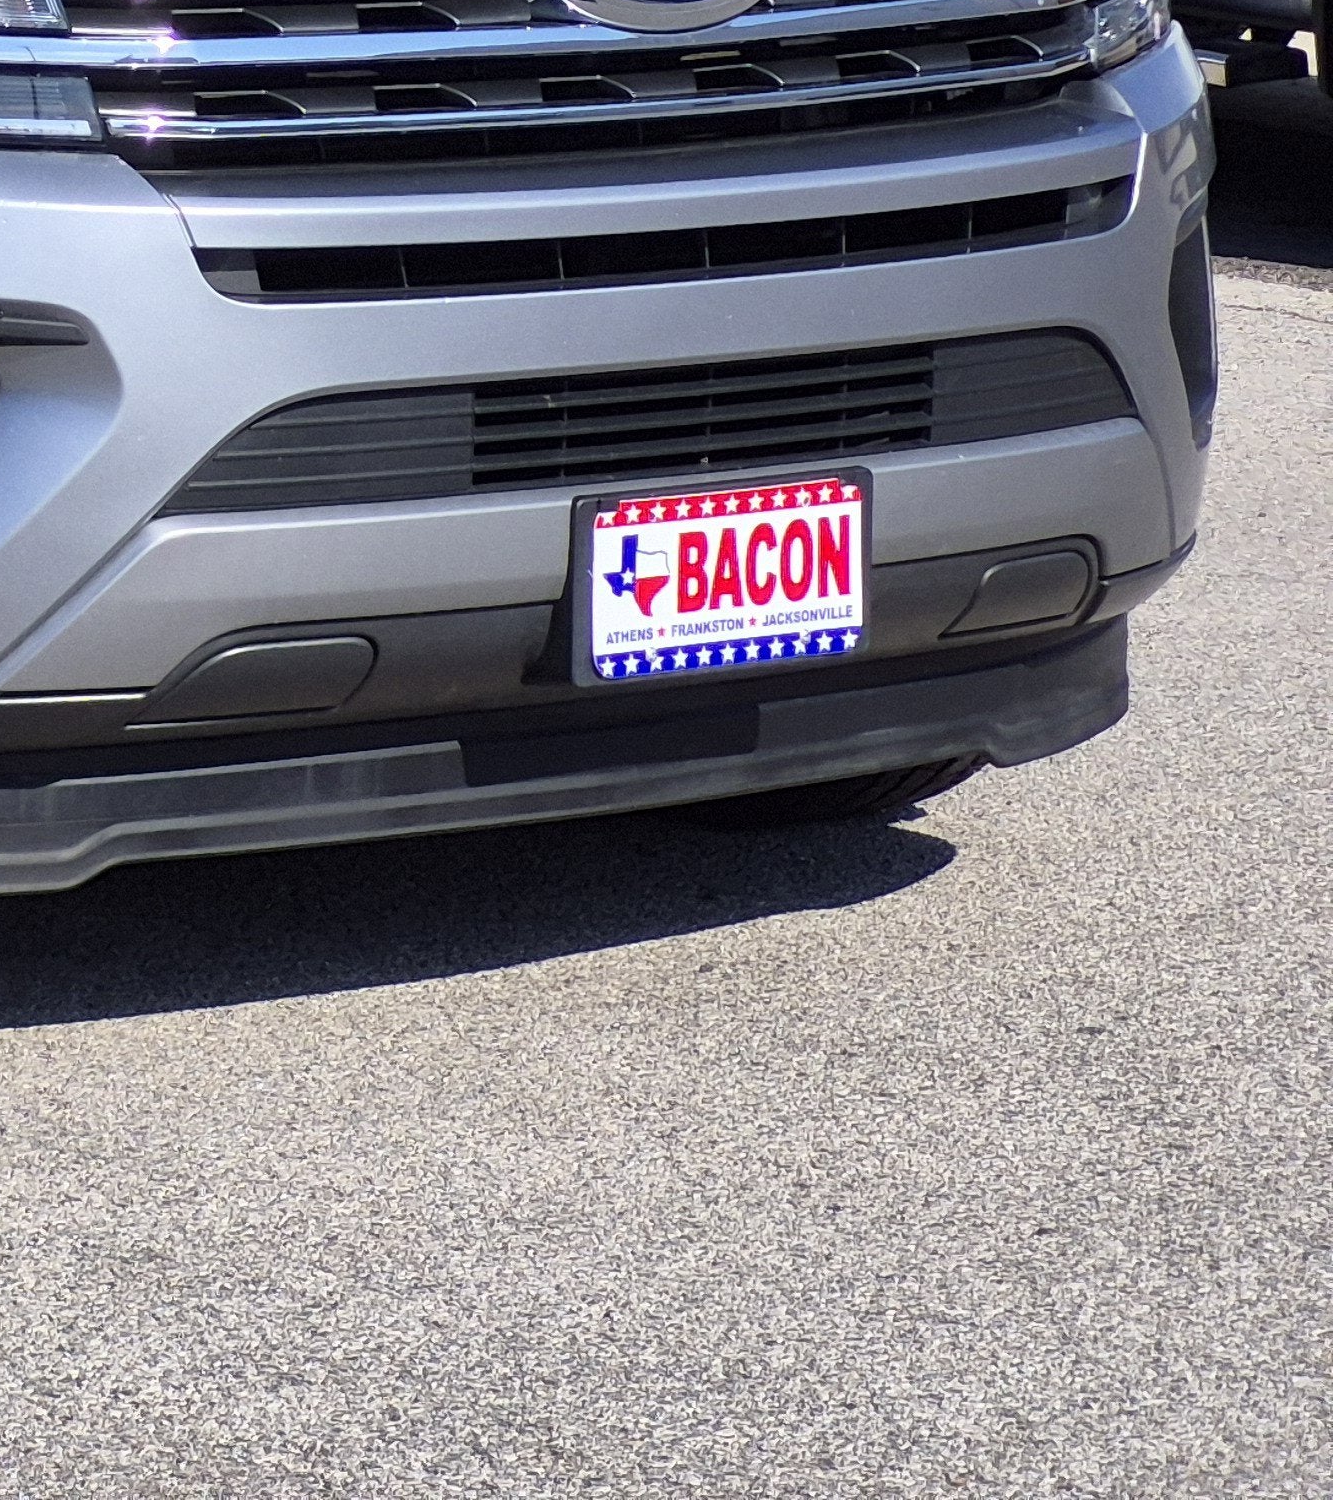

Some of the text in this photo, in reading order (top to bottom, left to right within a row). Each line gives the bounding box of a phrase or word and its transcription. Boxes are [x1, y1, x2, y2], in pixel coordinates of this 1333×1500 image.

[677, 514, 851, 614] BACON
[606, 605, 853, 645] ATHENS FRANKSTON JACKSONVILLE
